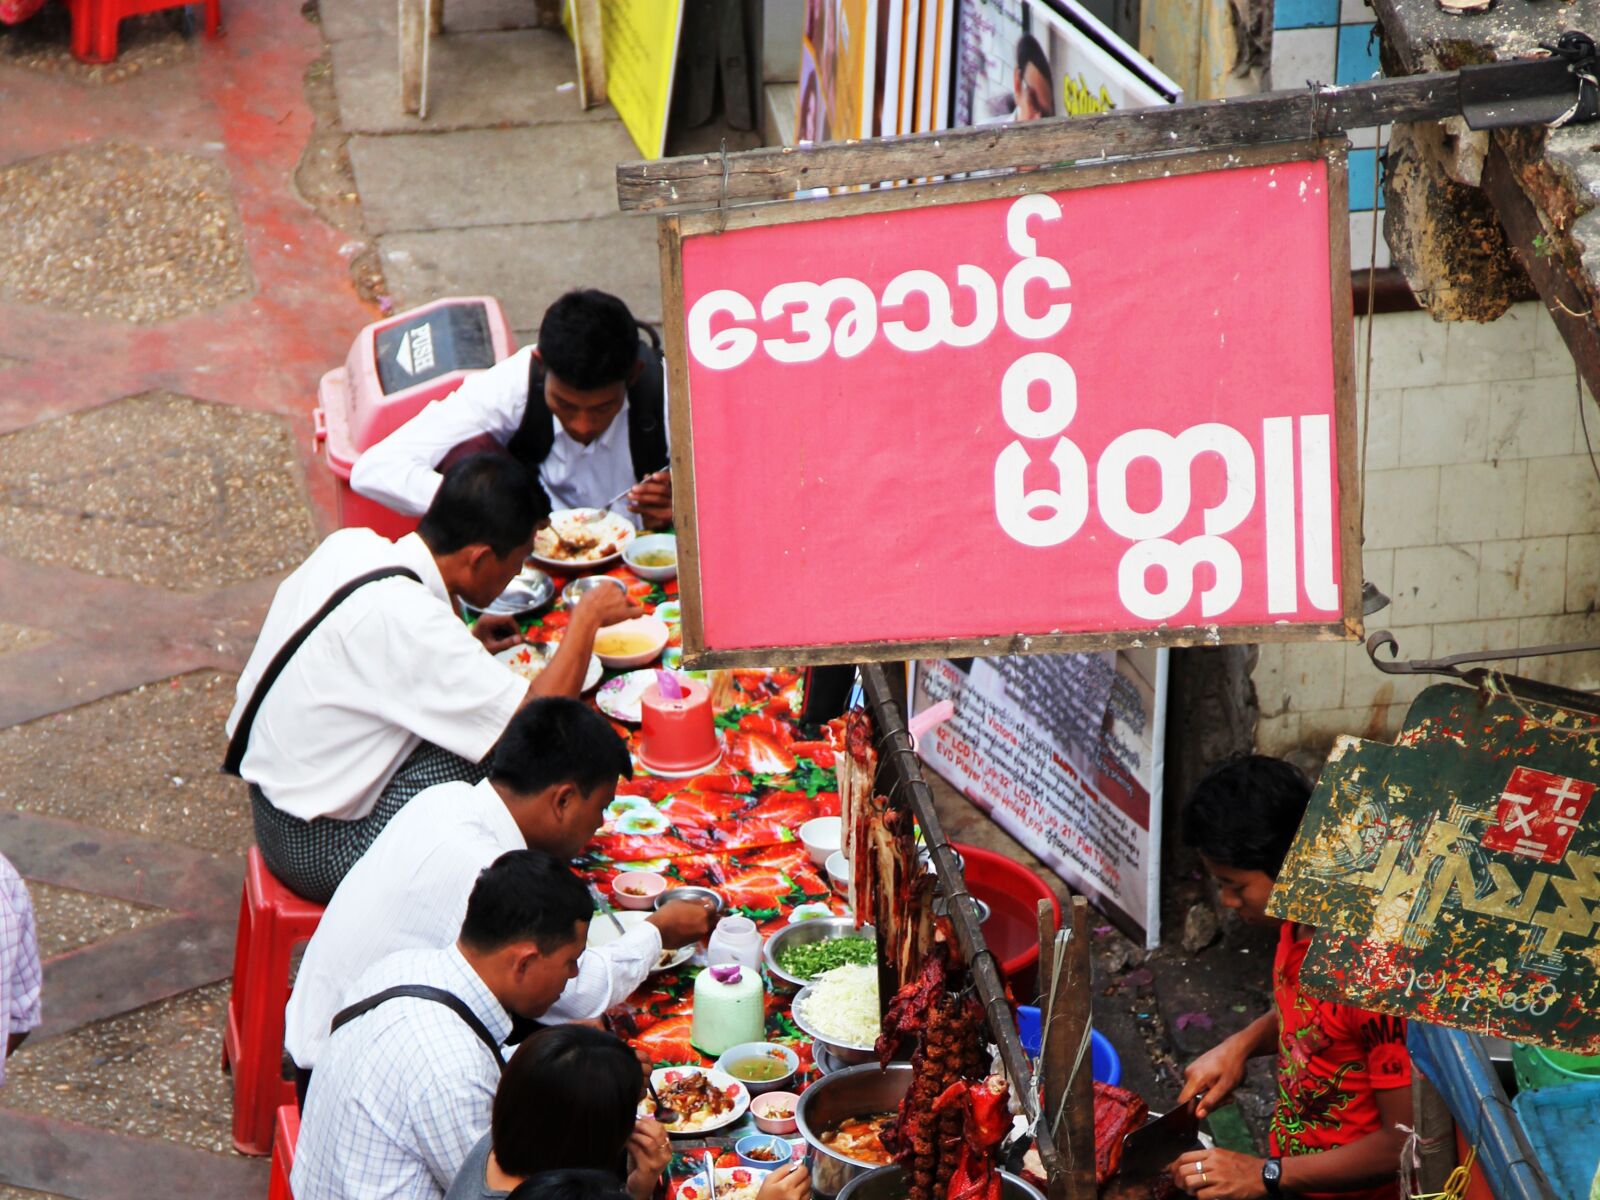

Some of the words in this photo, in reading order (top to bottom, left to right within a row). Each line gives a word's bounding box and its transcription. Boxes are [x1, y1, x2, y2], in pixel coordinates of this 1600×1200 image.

[410, 322, 434, 373] PUSH
[952, 738, 970, 759] LCD
[1014, 786, 1031, 806] LCD
